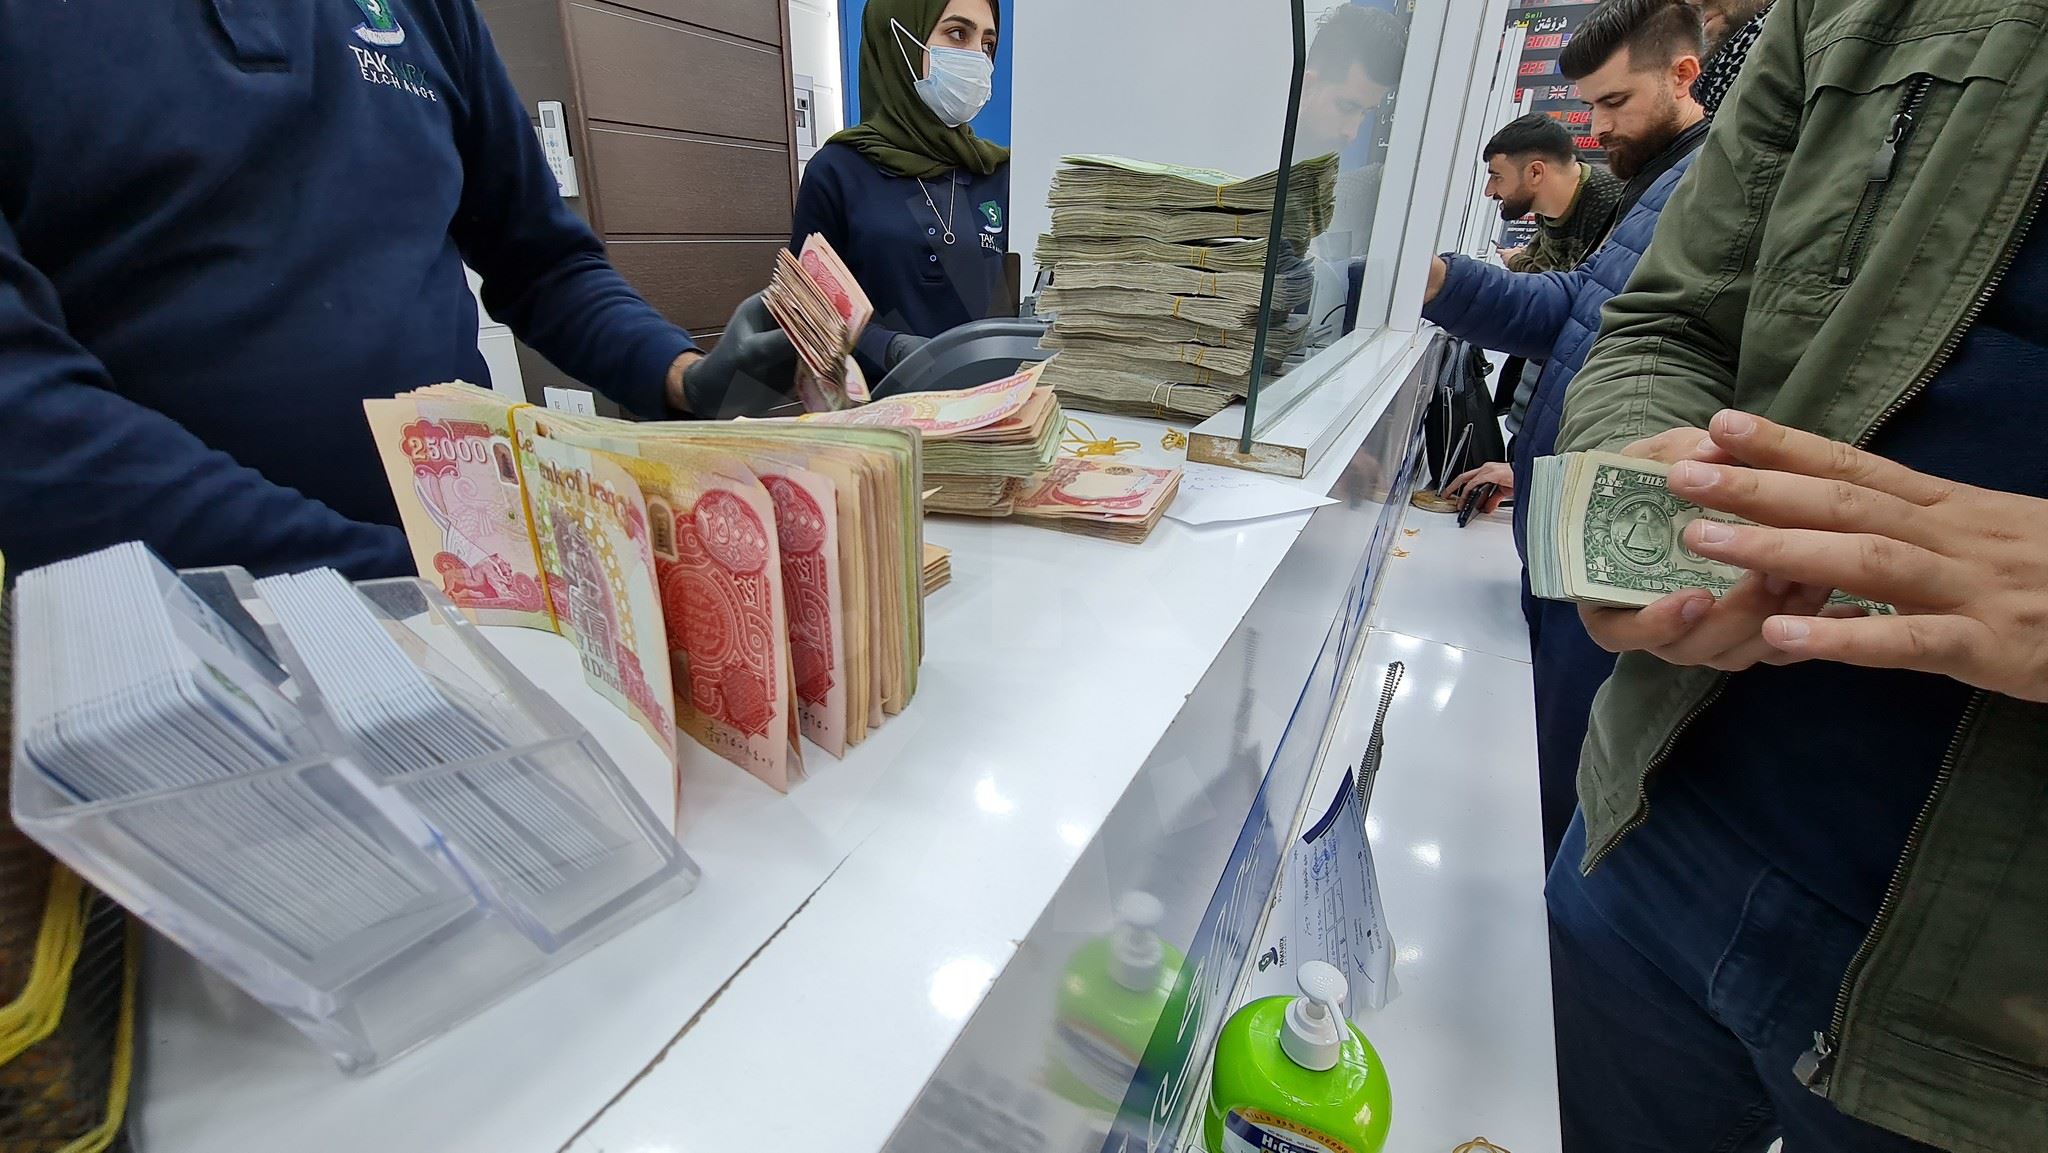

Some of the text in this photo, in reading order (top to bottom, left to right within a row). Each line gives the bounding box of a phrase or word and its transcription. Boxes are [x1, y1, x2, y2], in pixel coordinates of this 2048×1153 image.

[361, 66, 438, 102] EXCHANGE
[408, 437, 488, 464] 25000
[1636, 473, 1667, 488] THE
[1300, 1126, 1314, 1136] OF
